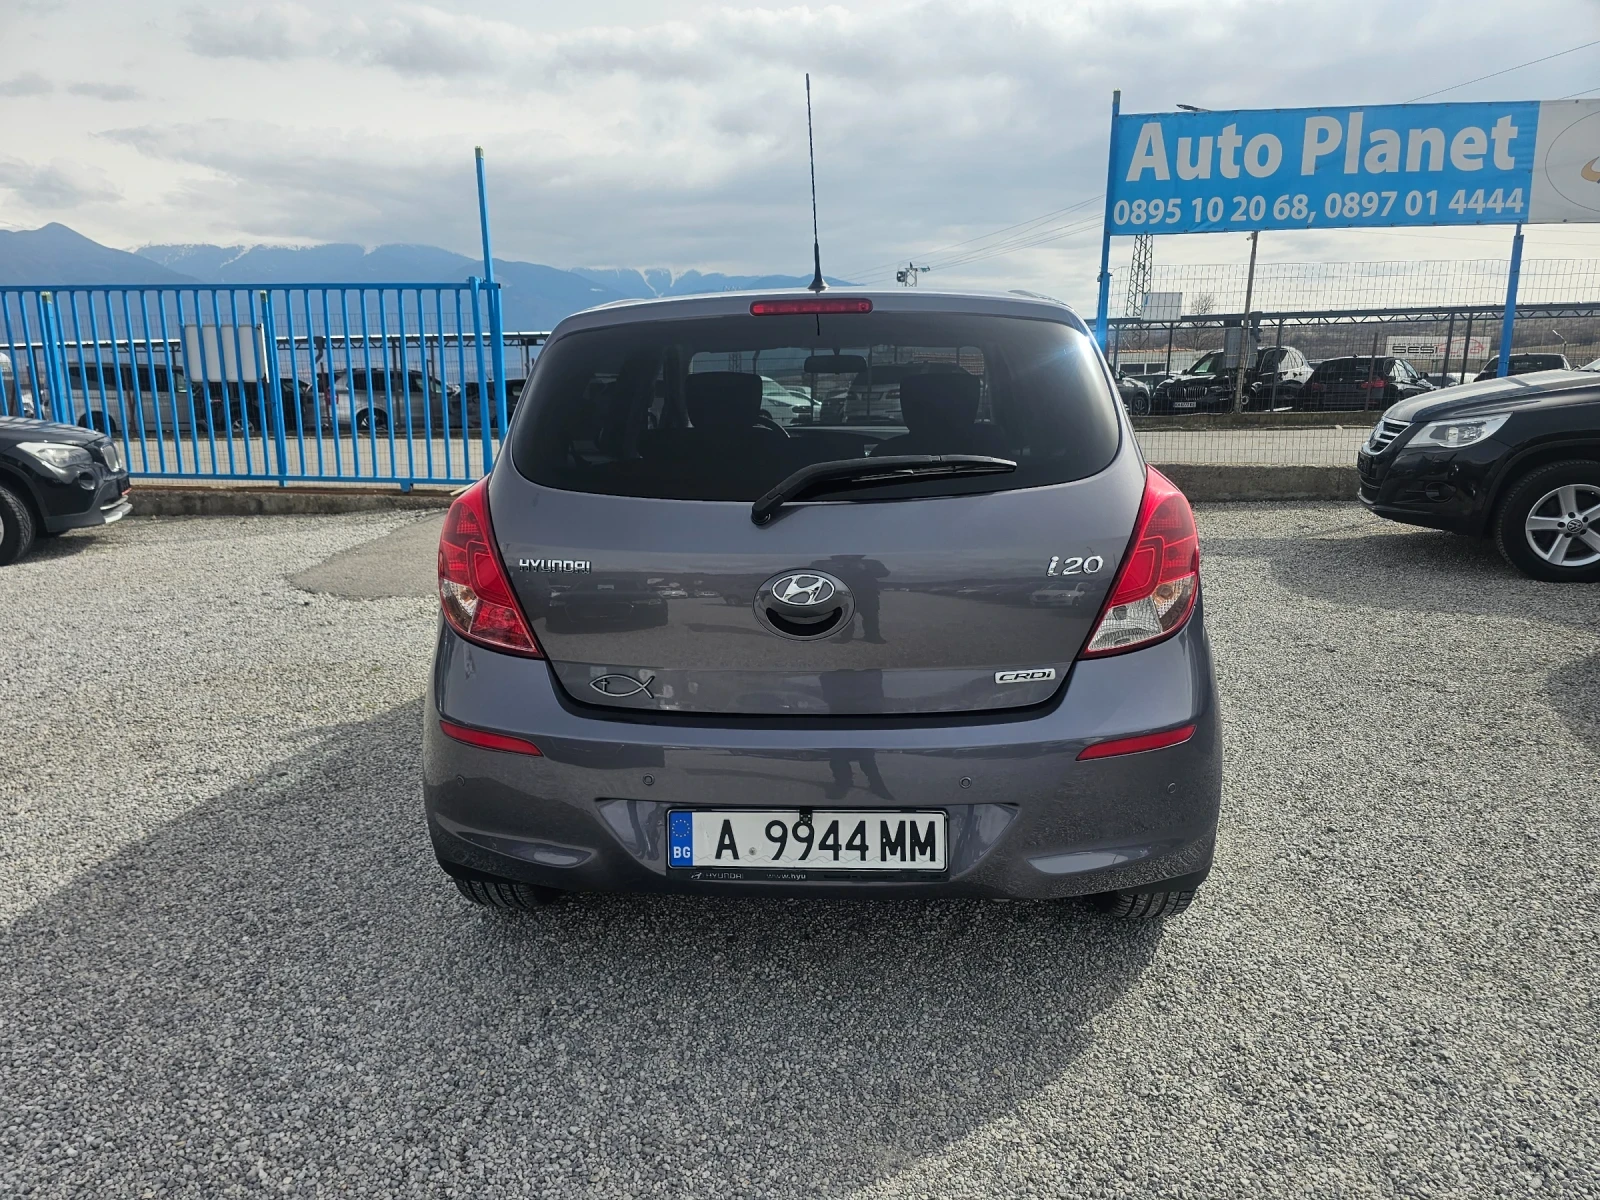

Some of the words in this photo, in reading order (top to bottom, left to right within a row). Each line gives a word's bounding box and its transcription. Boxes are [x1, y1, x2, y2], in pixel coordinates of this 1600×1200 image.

[1125, 122, 1283, 182] Auto
[1301, 111, 1519, 176] Planet
[1113, 198, 1182, 226] 0895
[1192, 197, 1225, 223] 10
[1230, 195, 1267, 222] 20
[1273, 194, 1317, 224] 68,
[1324, 191, 1398, 219] 0897
[1404, 189, 1438, 216] 01
[1448, 188, 1524, 215] 4444
[519, 558, 590, 574] HYUNDAI
[1046, 555, 1105, 577] i20
[998, 670, 1053, 681] CRDi
[715, 819, 740, 860] A
[765, 819, 869, 862] 9944
[880, 820, 936, 862] MM
[673, 846, 691, 860] BG
